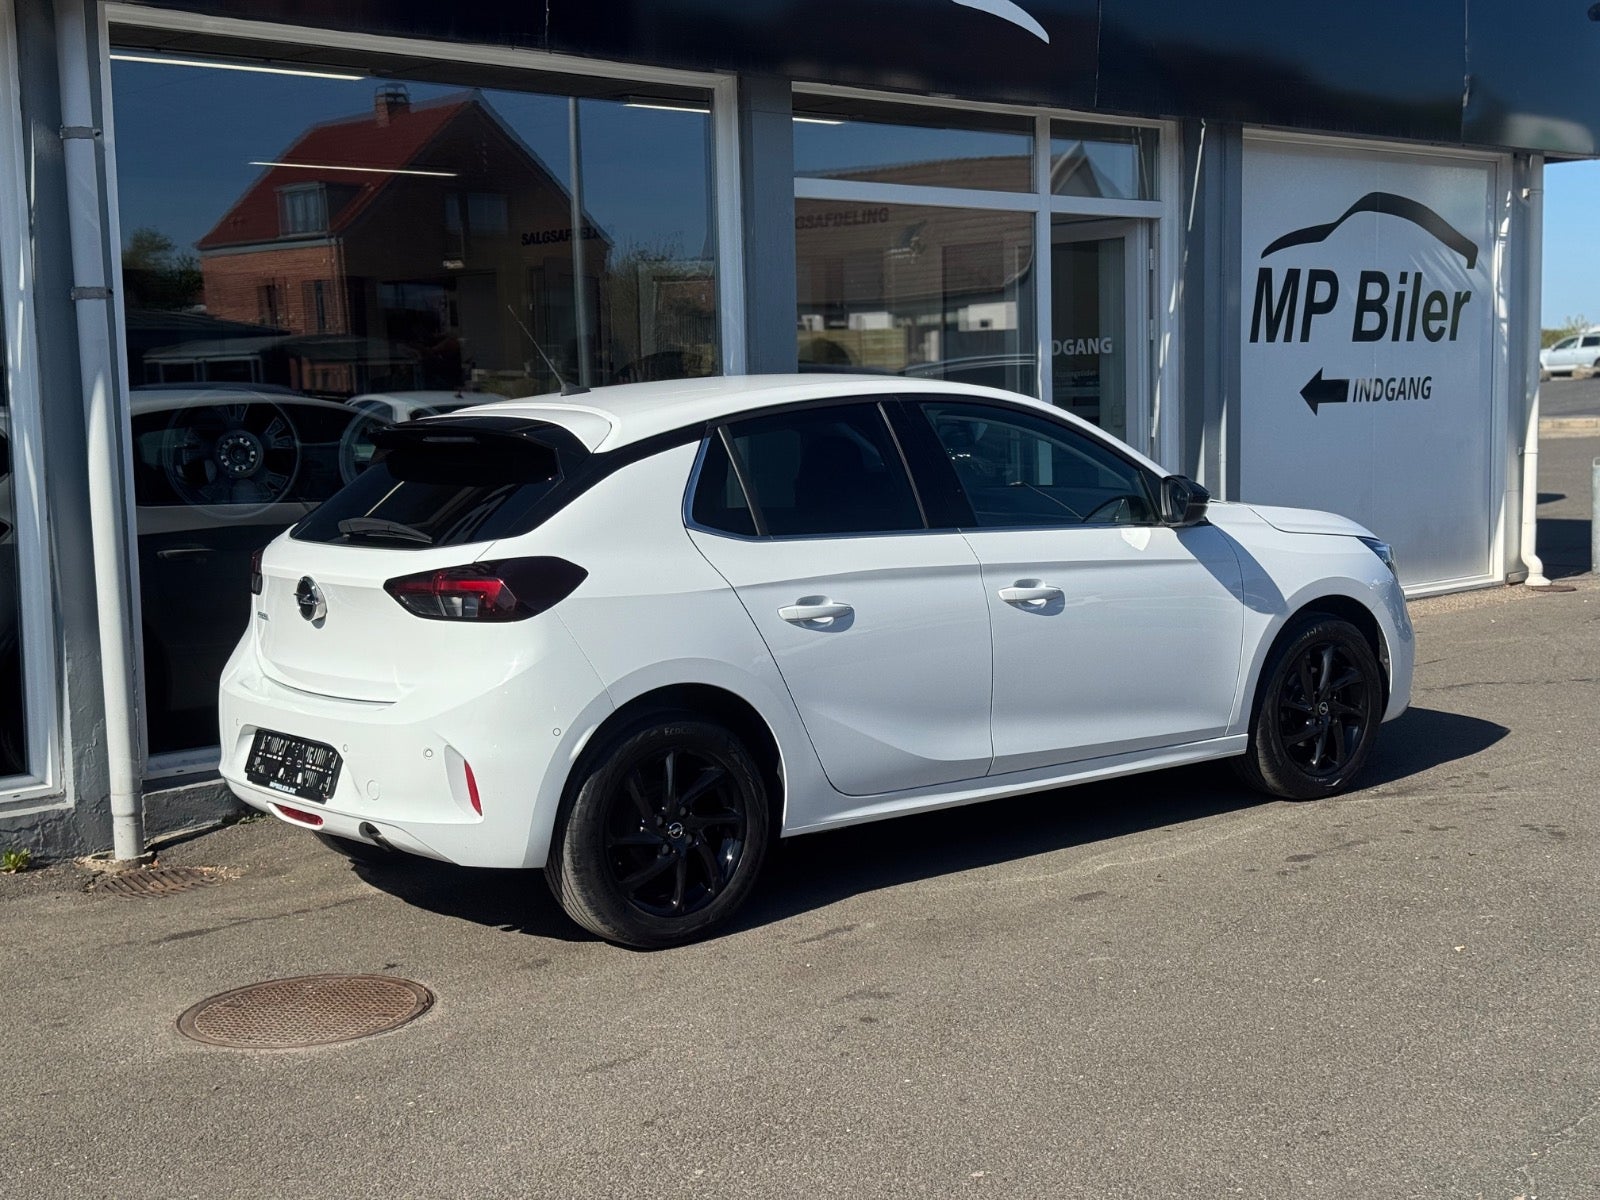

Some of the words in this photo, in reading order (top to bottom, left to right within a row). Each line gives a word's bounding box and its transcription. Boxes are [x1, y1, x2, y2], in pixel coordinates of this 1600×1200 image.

[1249, 267, 1340, 343] MP
[1352, 270, 1472, 343] Biler
[1353, 376, 1432, 402] INDGANG
